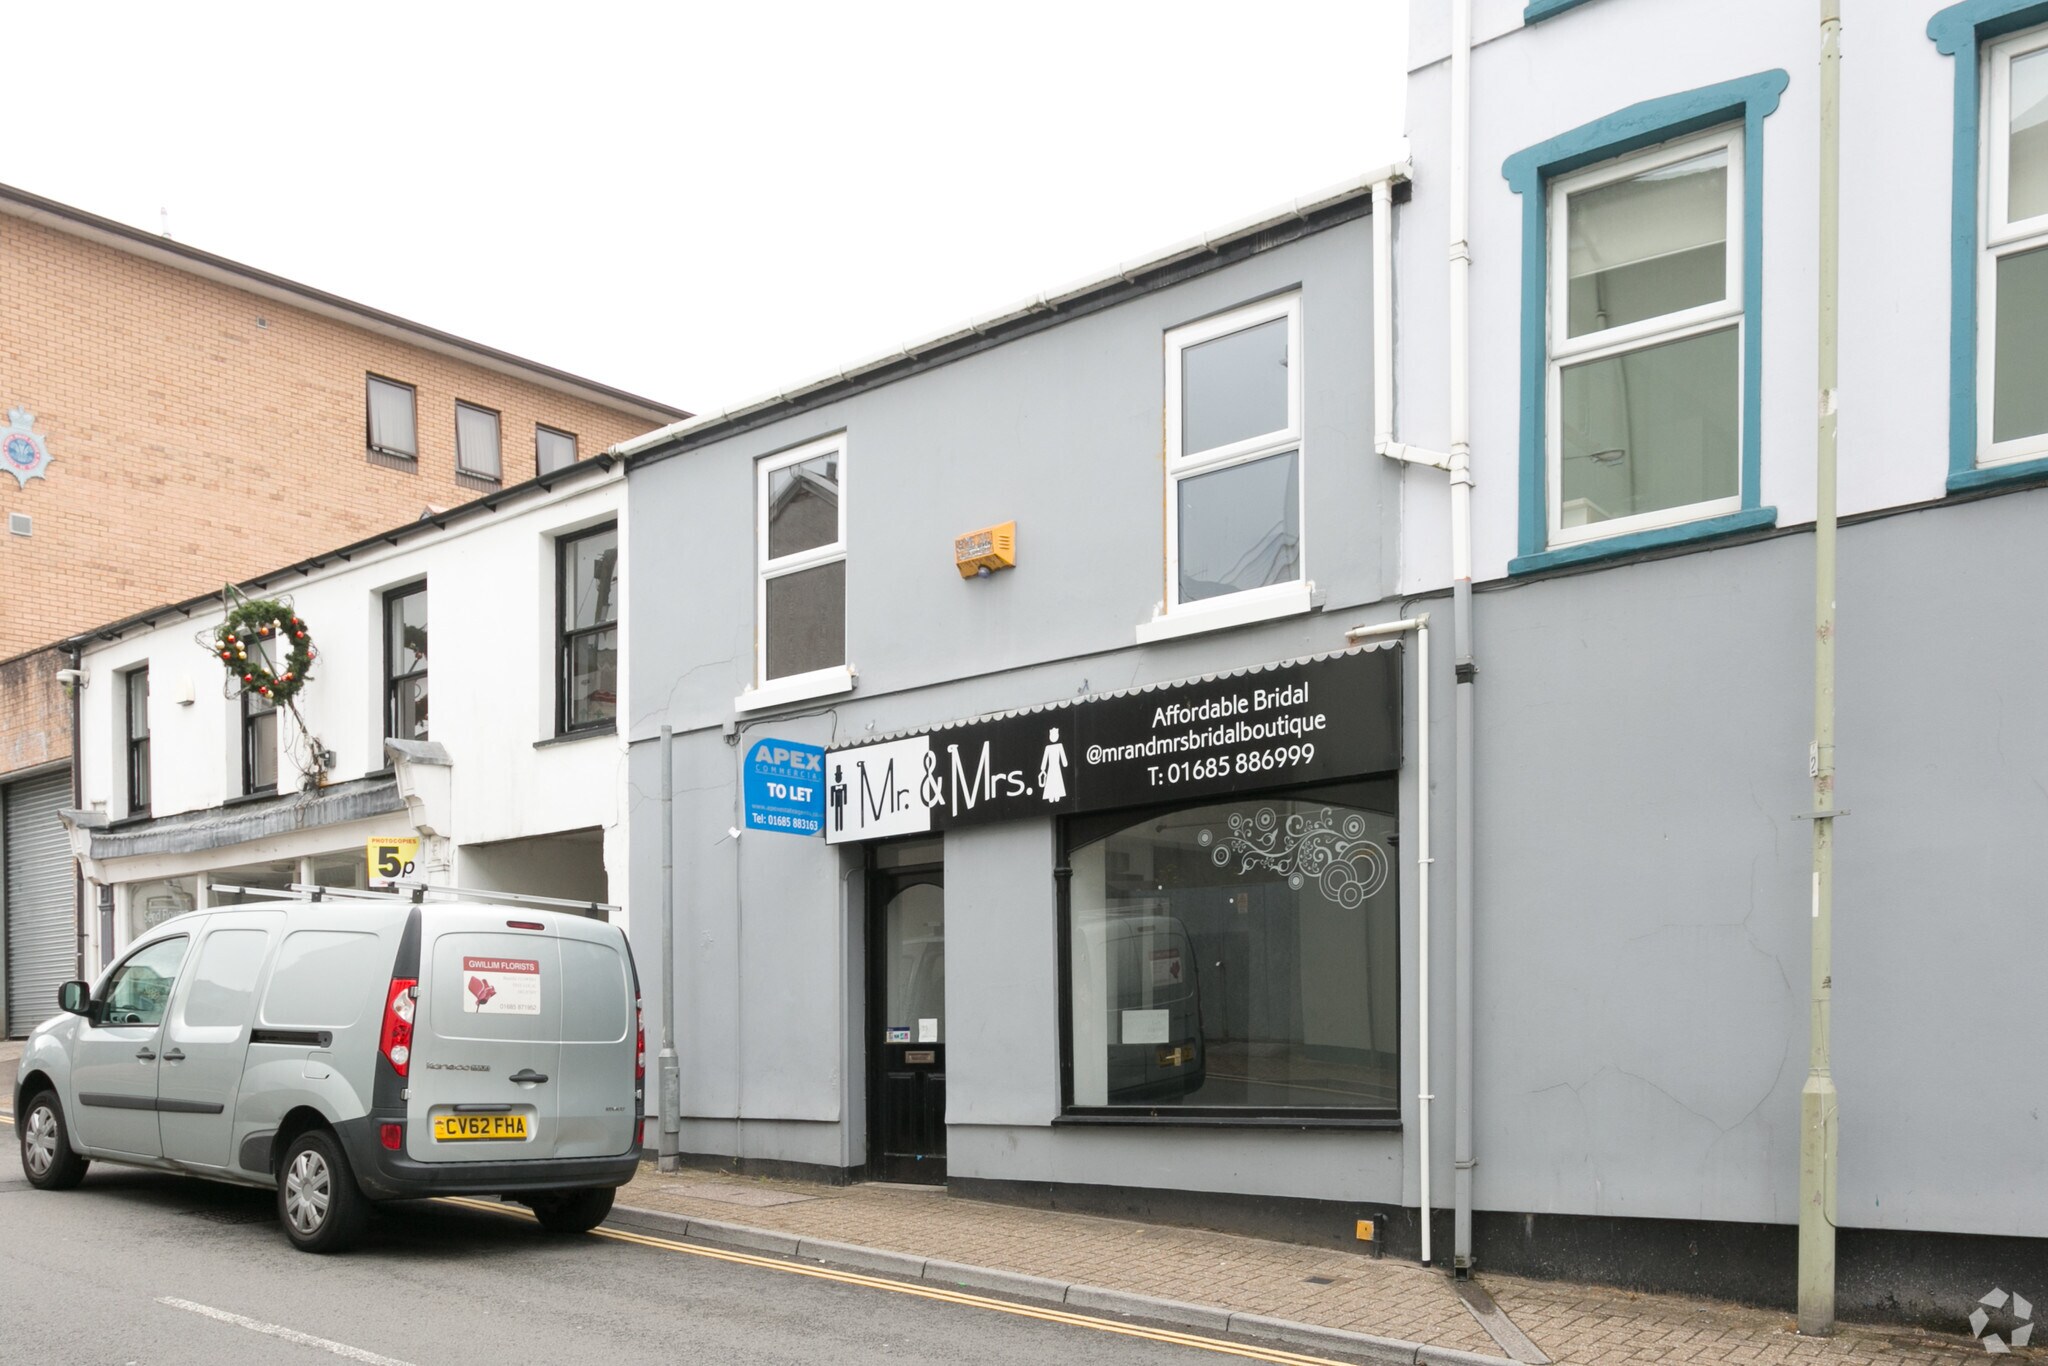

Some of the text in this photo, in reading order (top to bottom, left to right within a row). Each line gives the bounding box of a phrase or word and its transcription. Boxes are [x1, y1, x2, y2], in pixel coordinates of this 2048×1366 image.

[1152, 681, 1309, 728] Affordable Bridal
[1086, 712, 1326, 765] @mrandmrsbridalboutique
[755, 744, 822, 773] APEX
[755, 763, 821, 781] COMMERCIA
[1148, 742, 1316, 786] T: 01685 886999
[766, 782, 813, 803] TO LET
[857, 740, 1033, 829] Mr. & Mrs.
[752, 812, 819, 831] Tel: 01685 883163
[378, 845, 415, 878] 5p
[468, 959, 535, 971] GWILLIM FLORISTS
[446, 1117, 525, 1135] CV62 FHA
